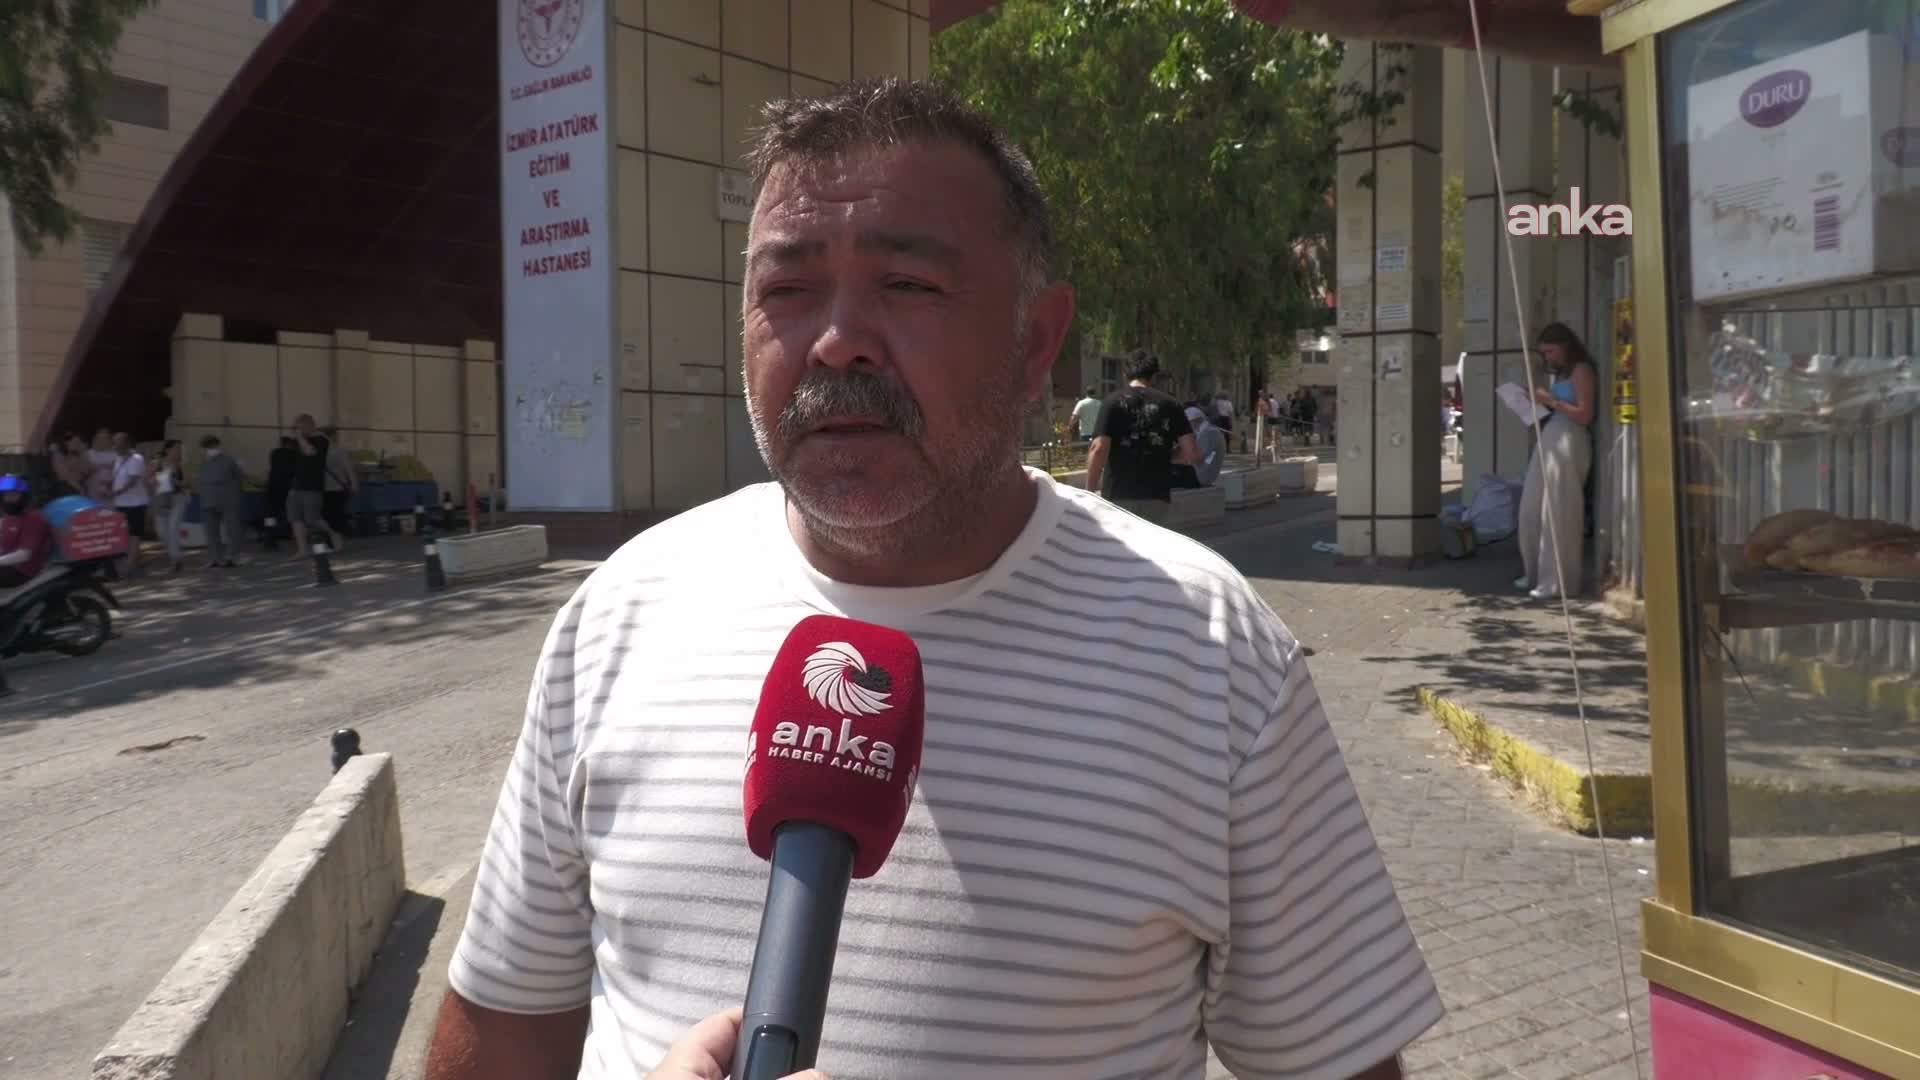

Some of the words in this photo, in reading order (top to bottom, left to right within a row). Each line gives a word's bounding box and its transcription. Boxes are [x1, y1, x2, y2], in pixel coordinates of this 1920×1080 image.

[1748, 79, 1804, 114] DURU
[506, 129, 537, 152] İZMİR
[539, 113, 598, 145] ATATÜRK
[528, 152, 570, 178] EĞİTİM
[543, 188, 560, 209] VE
[520, 217, 590, 247] ARAŞTIRMA
[523, 246, 591, 277] HASTANESİ
[771, 718, 896, 769] anka
[767, 746, 825, 764] HABER
[829, 756, 893, 783] AJANSI
